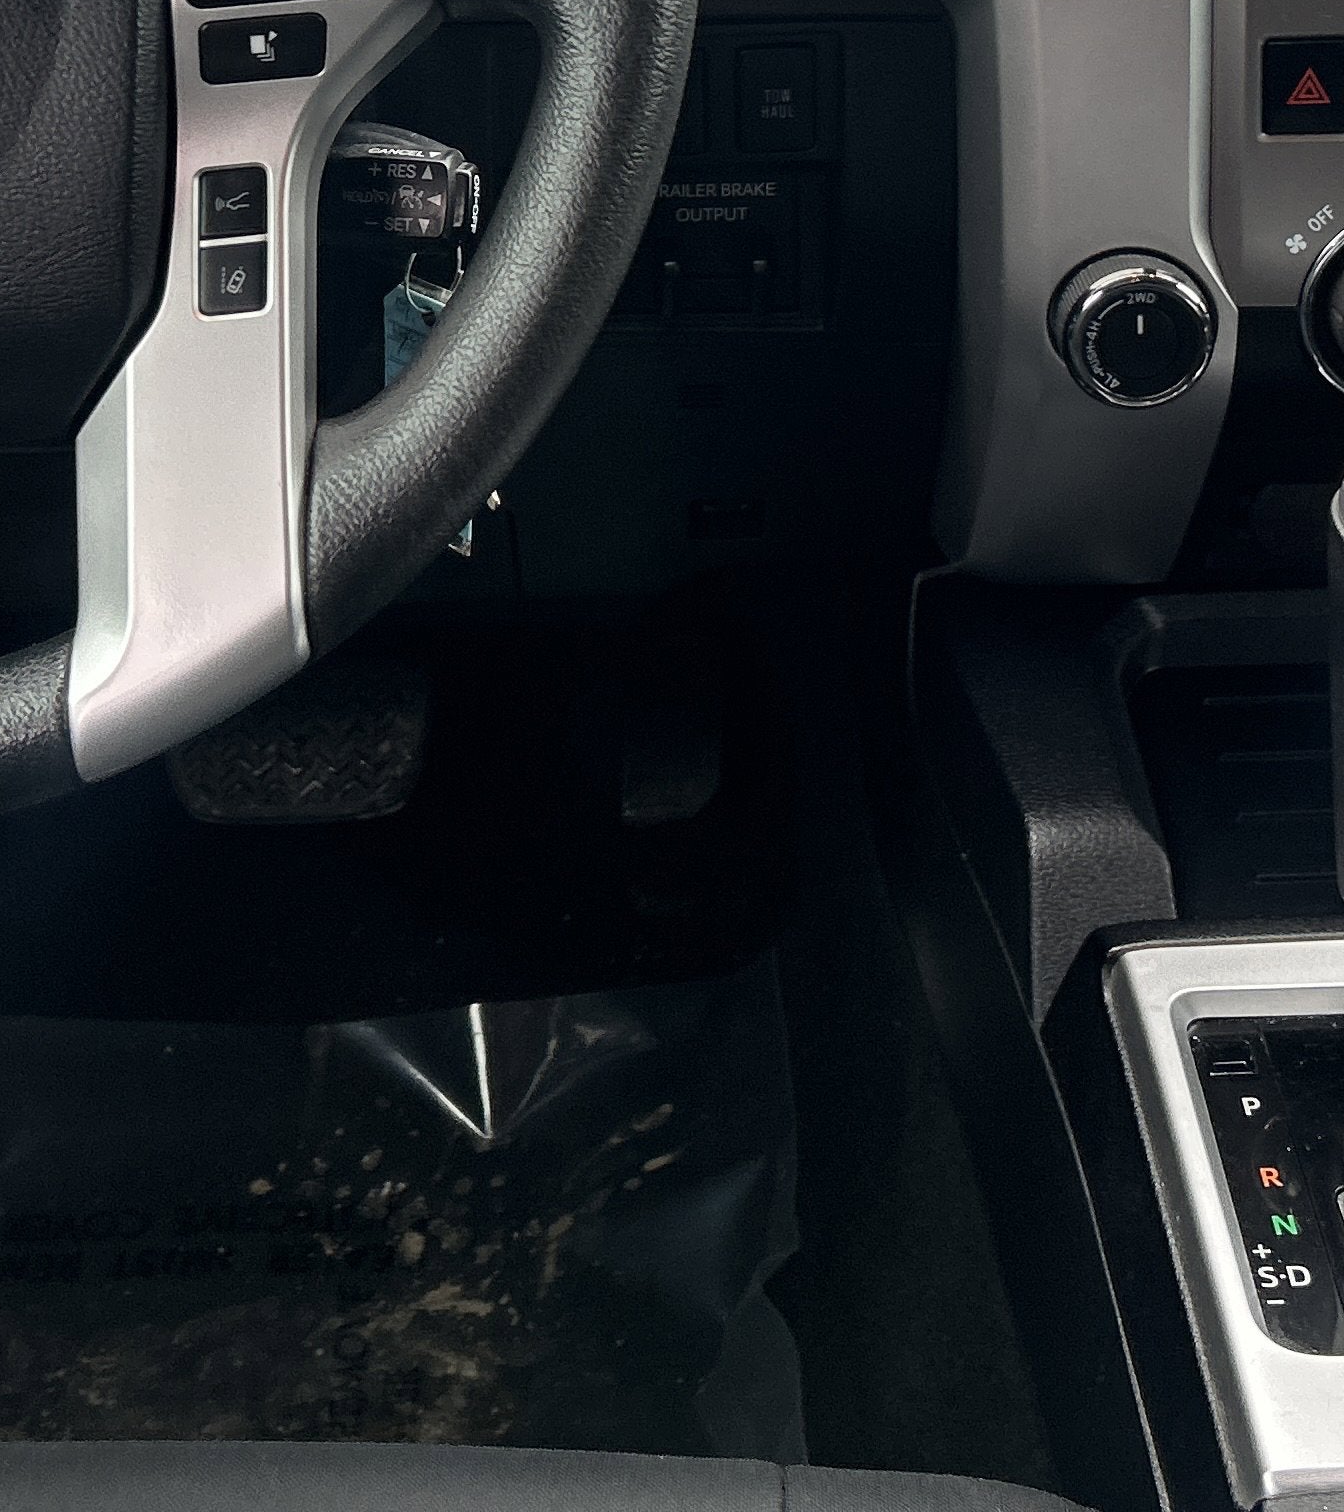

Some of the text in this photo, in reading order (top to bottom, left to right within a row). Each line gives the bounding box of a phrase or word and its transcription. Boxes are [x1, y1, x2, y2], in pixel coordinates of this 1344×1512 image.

[367, 147, 426, 158] CANCEL
[386, 162, 417, 180] RES
[659, 181, 777, 198] RAILER BRAKE
[675, 206, 750, 223] OUTPUT
[1308, 205, 1337, 233] OFF
[383, 216, 414, 233] SET
[1125, 292, 1158, 306] 2WD
[1240, 1096, 1262, 1116] P
[1258, 1166, 1285, 1188] R
[1270, 1213, 1299, 1237] N
